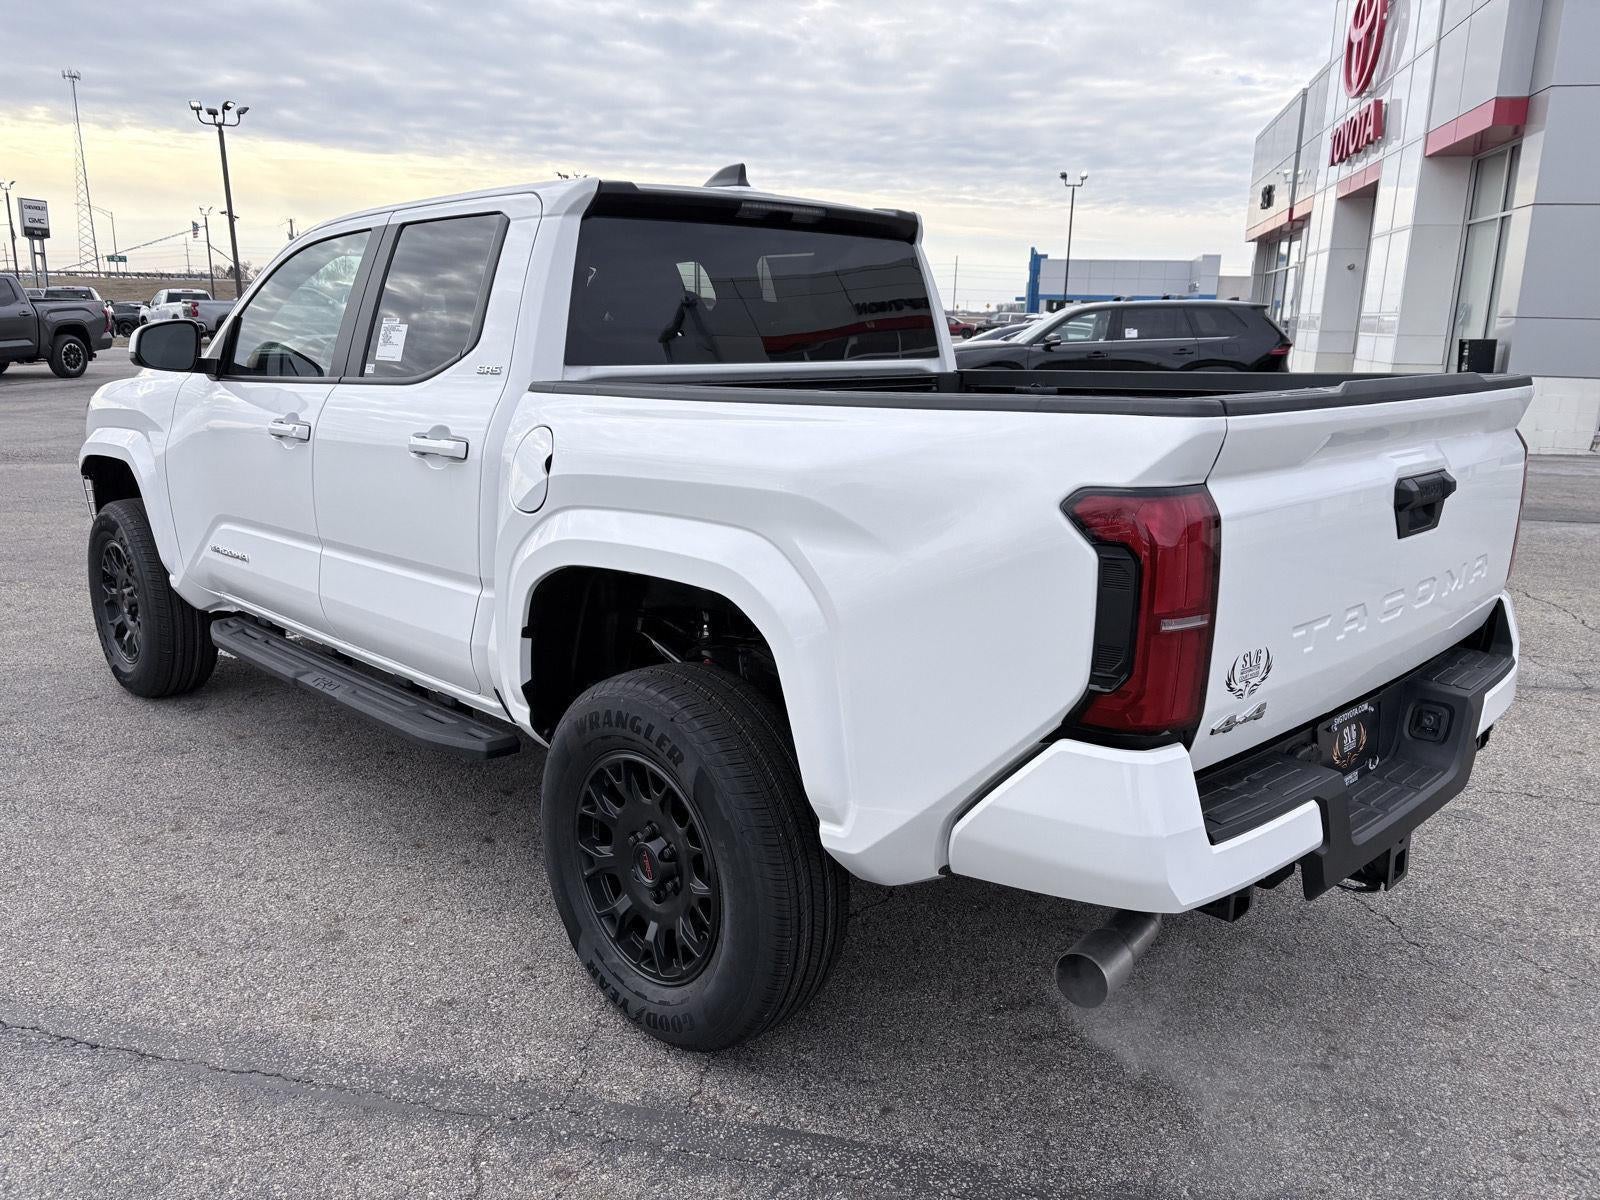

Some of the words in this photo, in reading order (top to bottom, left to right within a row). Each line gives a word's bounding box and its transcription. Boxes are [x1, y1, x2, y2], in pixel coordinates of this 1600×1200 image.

[1328, 100, 1381, 168] TOYOTA
[476, 365, 502, 376] SR5
[1292, 553, 1489, 653] TACOMA
[1241, 648, 1262, 669] SVG
[311, 676, 341, 691] TRD
[574, 709, 685, 768] WRANGLER
